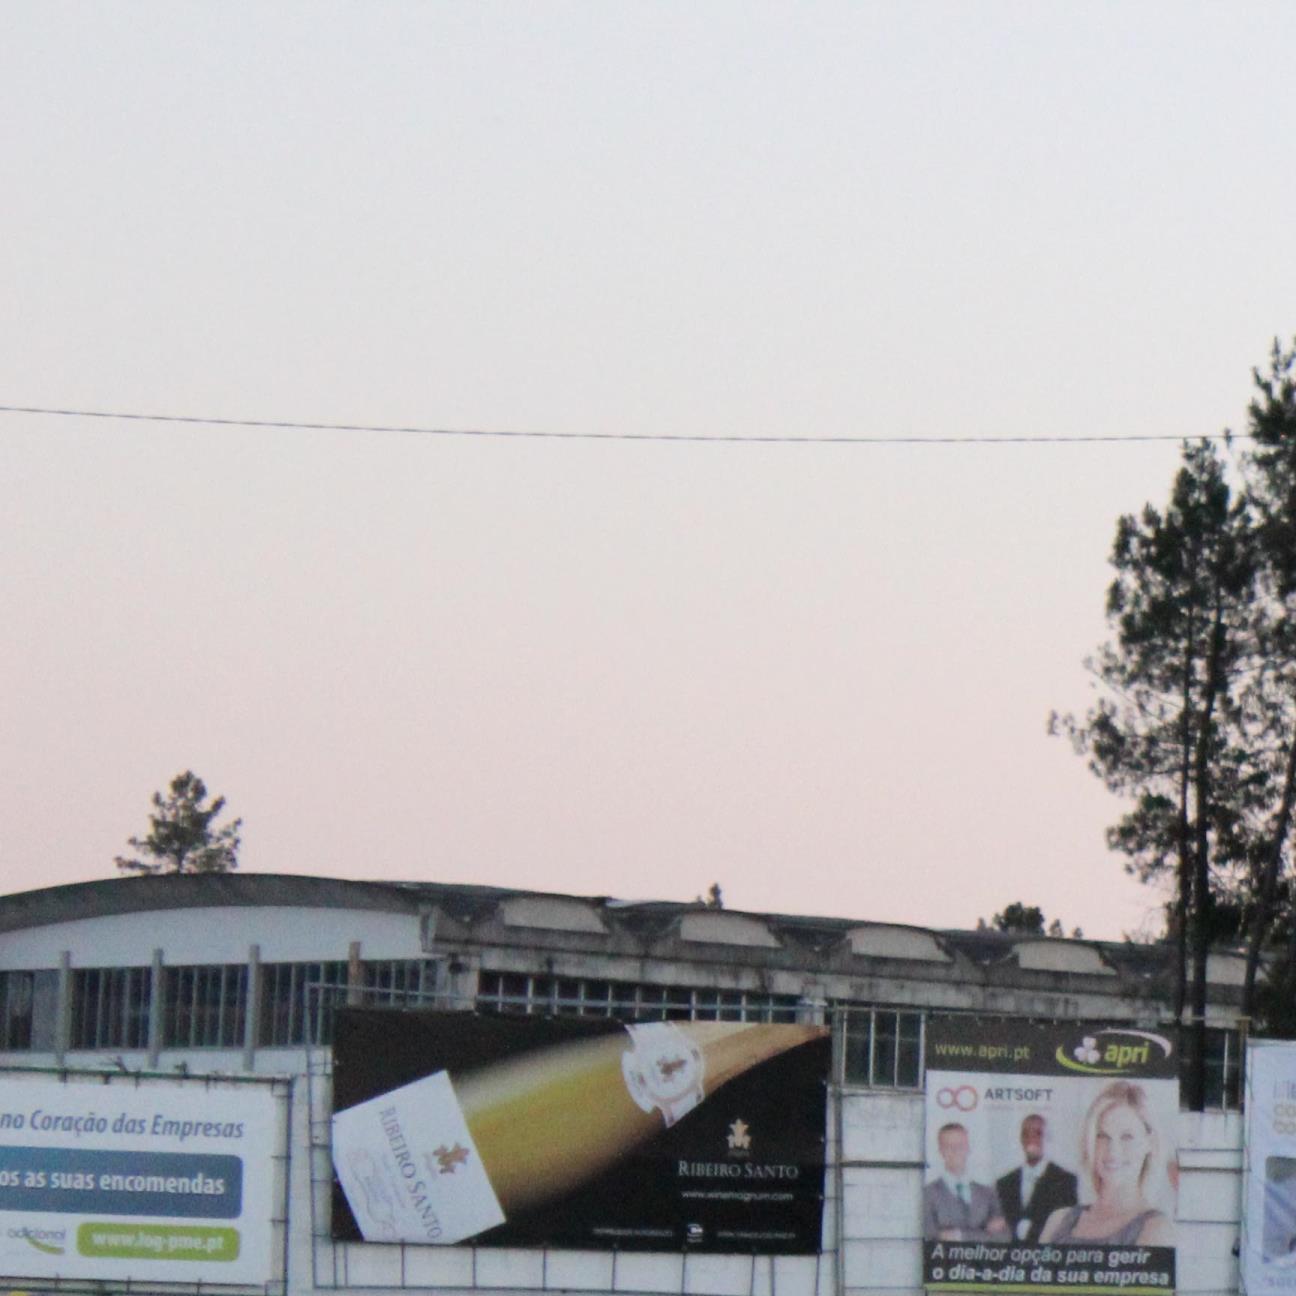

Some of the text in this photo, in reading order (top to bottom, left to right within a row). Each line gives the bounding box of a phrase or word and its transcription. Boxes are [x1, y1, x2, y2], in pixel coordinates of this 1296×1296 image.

[935, 1043, 1031, 1060] www.apri.pt
[1104, 1041, 1149, 1068] apri
[984, 1088, 1053, 1101] ARTSOFT
[0, 1109, 244, 1142] no Coração das Empresas
[380, 1106, 443, 1239] RIBEIRO SANTO
[678, 1160, 799, 1179] RIBEIRO SANTO
[24, 1171, 46, 1188] as
[51, 1172, 95, 1190] suas
[100, 1173, 225, 1195] encomendas
[931, 1244, 1151, 1267] A melhor opção para gerir
[932, 1264, 1170, 1287] o dia-a-dia da sua empresa
